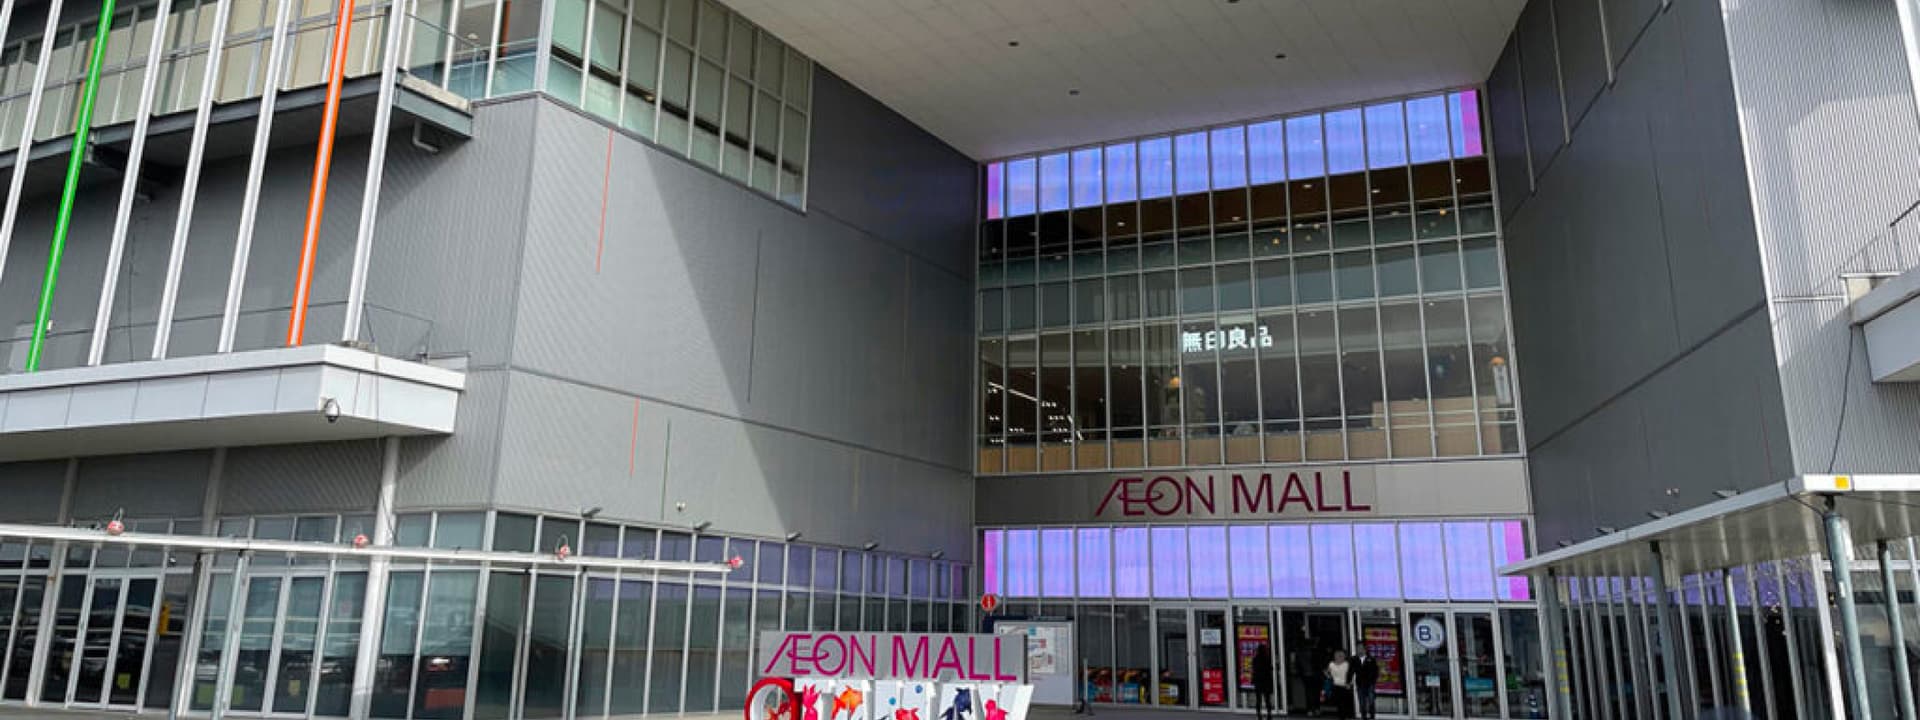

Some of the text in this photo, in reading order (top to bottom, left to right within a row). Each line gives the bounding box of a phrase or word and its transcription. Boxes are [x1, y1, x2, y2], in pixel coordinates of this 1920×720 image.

[1182, 326, 1272, 353] 無印良品
[1232, 471, 1371, 513] MALL
[891, 635, 1017, 681] MALL
